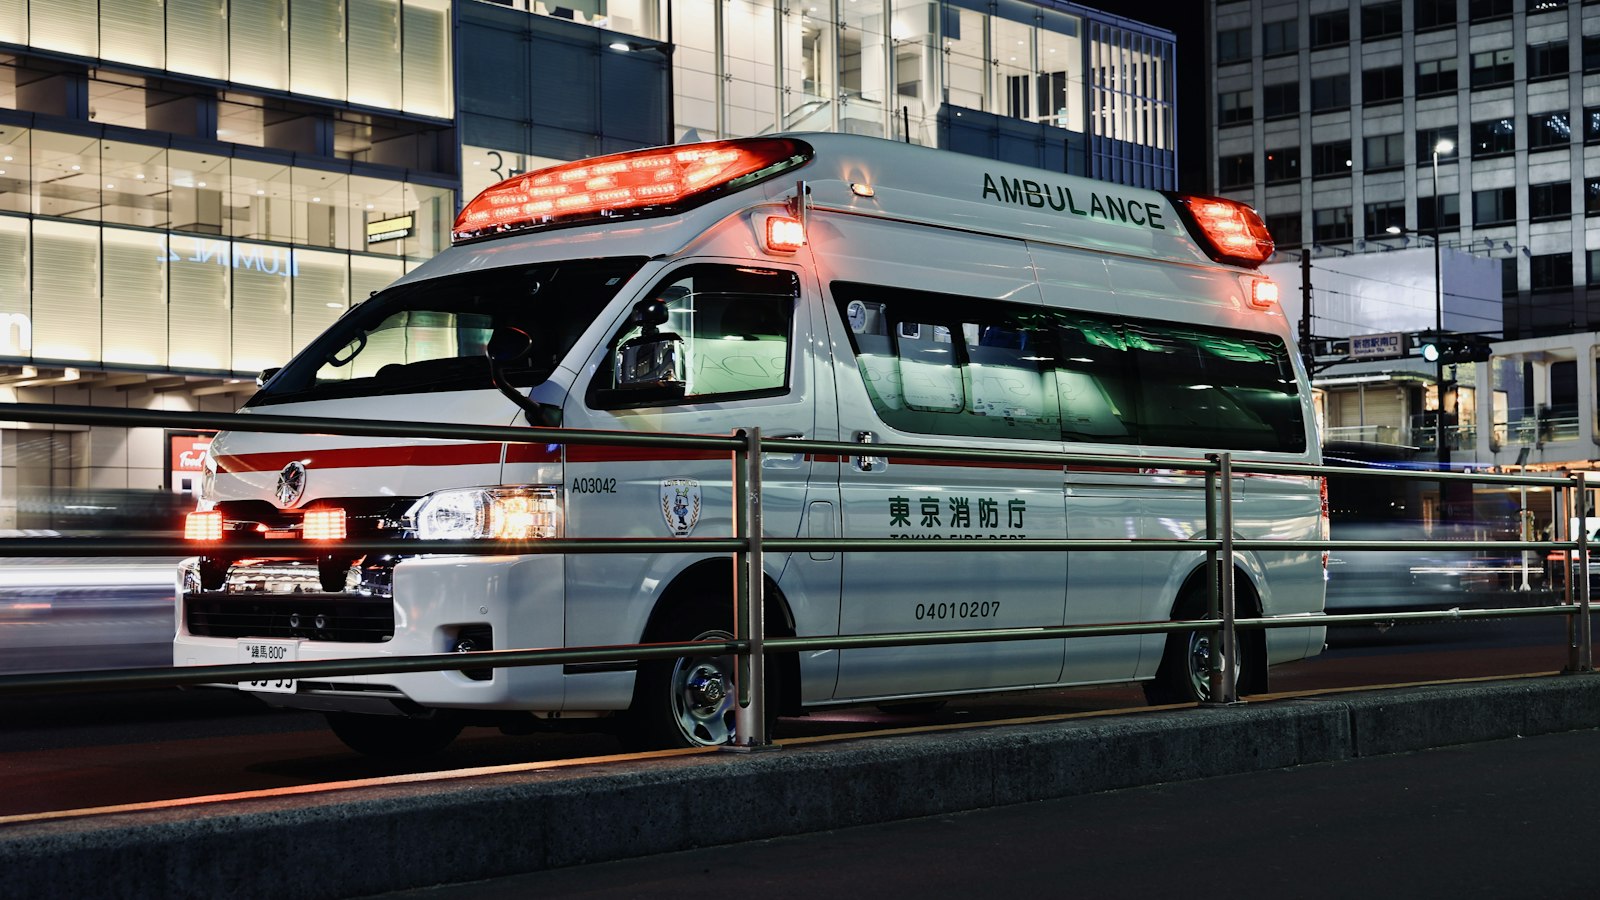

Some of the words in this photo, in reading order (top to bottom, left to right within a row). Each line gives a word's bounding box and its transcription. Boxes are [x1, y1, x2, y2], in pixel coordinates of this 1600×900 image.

[982, 172, 1165, 230] AMBULANCE
[572, 477, 617, 494] A03042
[888, 495, 1027, 529] 東京消防庁
[915, 601, 1000, 621] 04010207
[268, 646, 284, 660] 800
